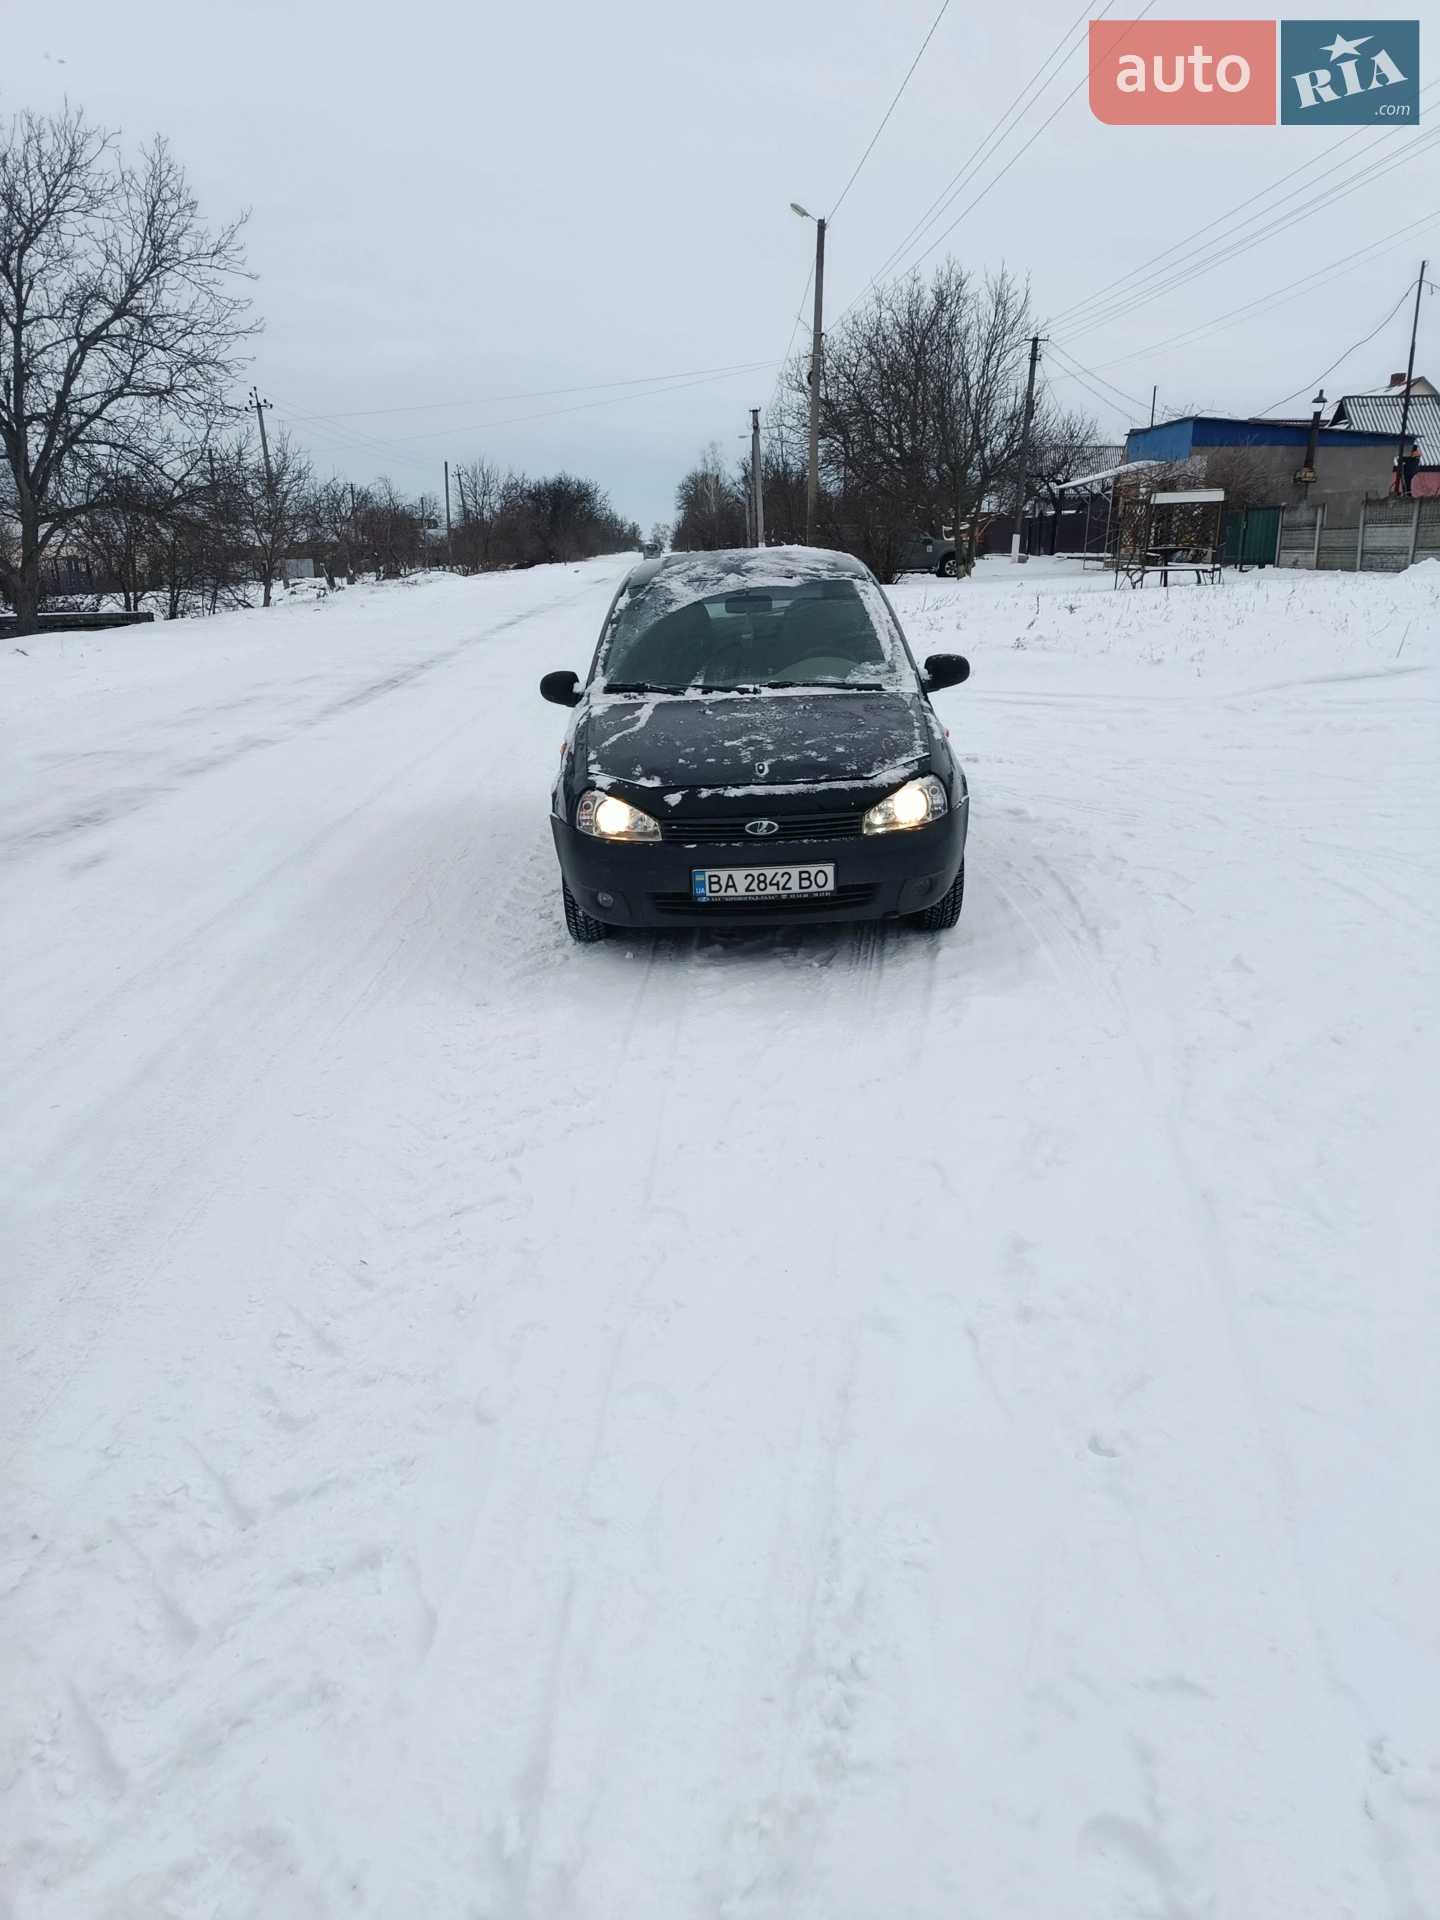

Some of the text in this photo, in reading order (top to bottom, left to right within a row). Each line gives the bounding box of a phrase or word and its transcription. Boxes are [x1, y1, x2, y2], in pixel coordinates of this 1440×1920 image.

[708, 869, 828, 894] BA 2842 BO
[695, 887, 706, 895] UA
